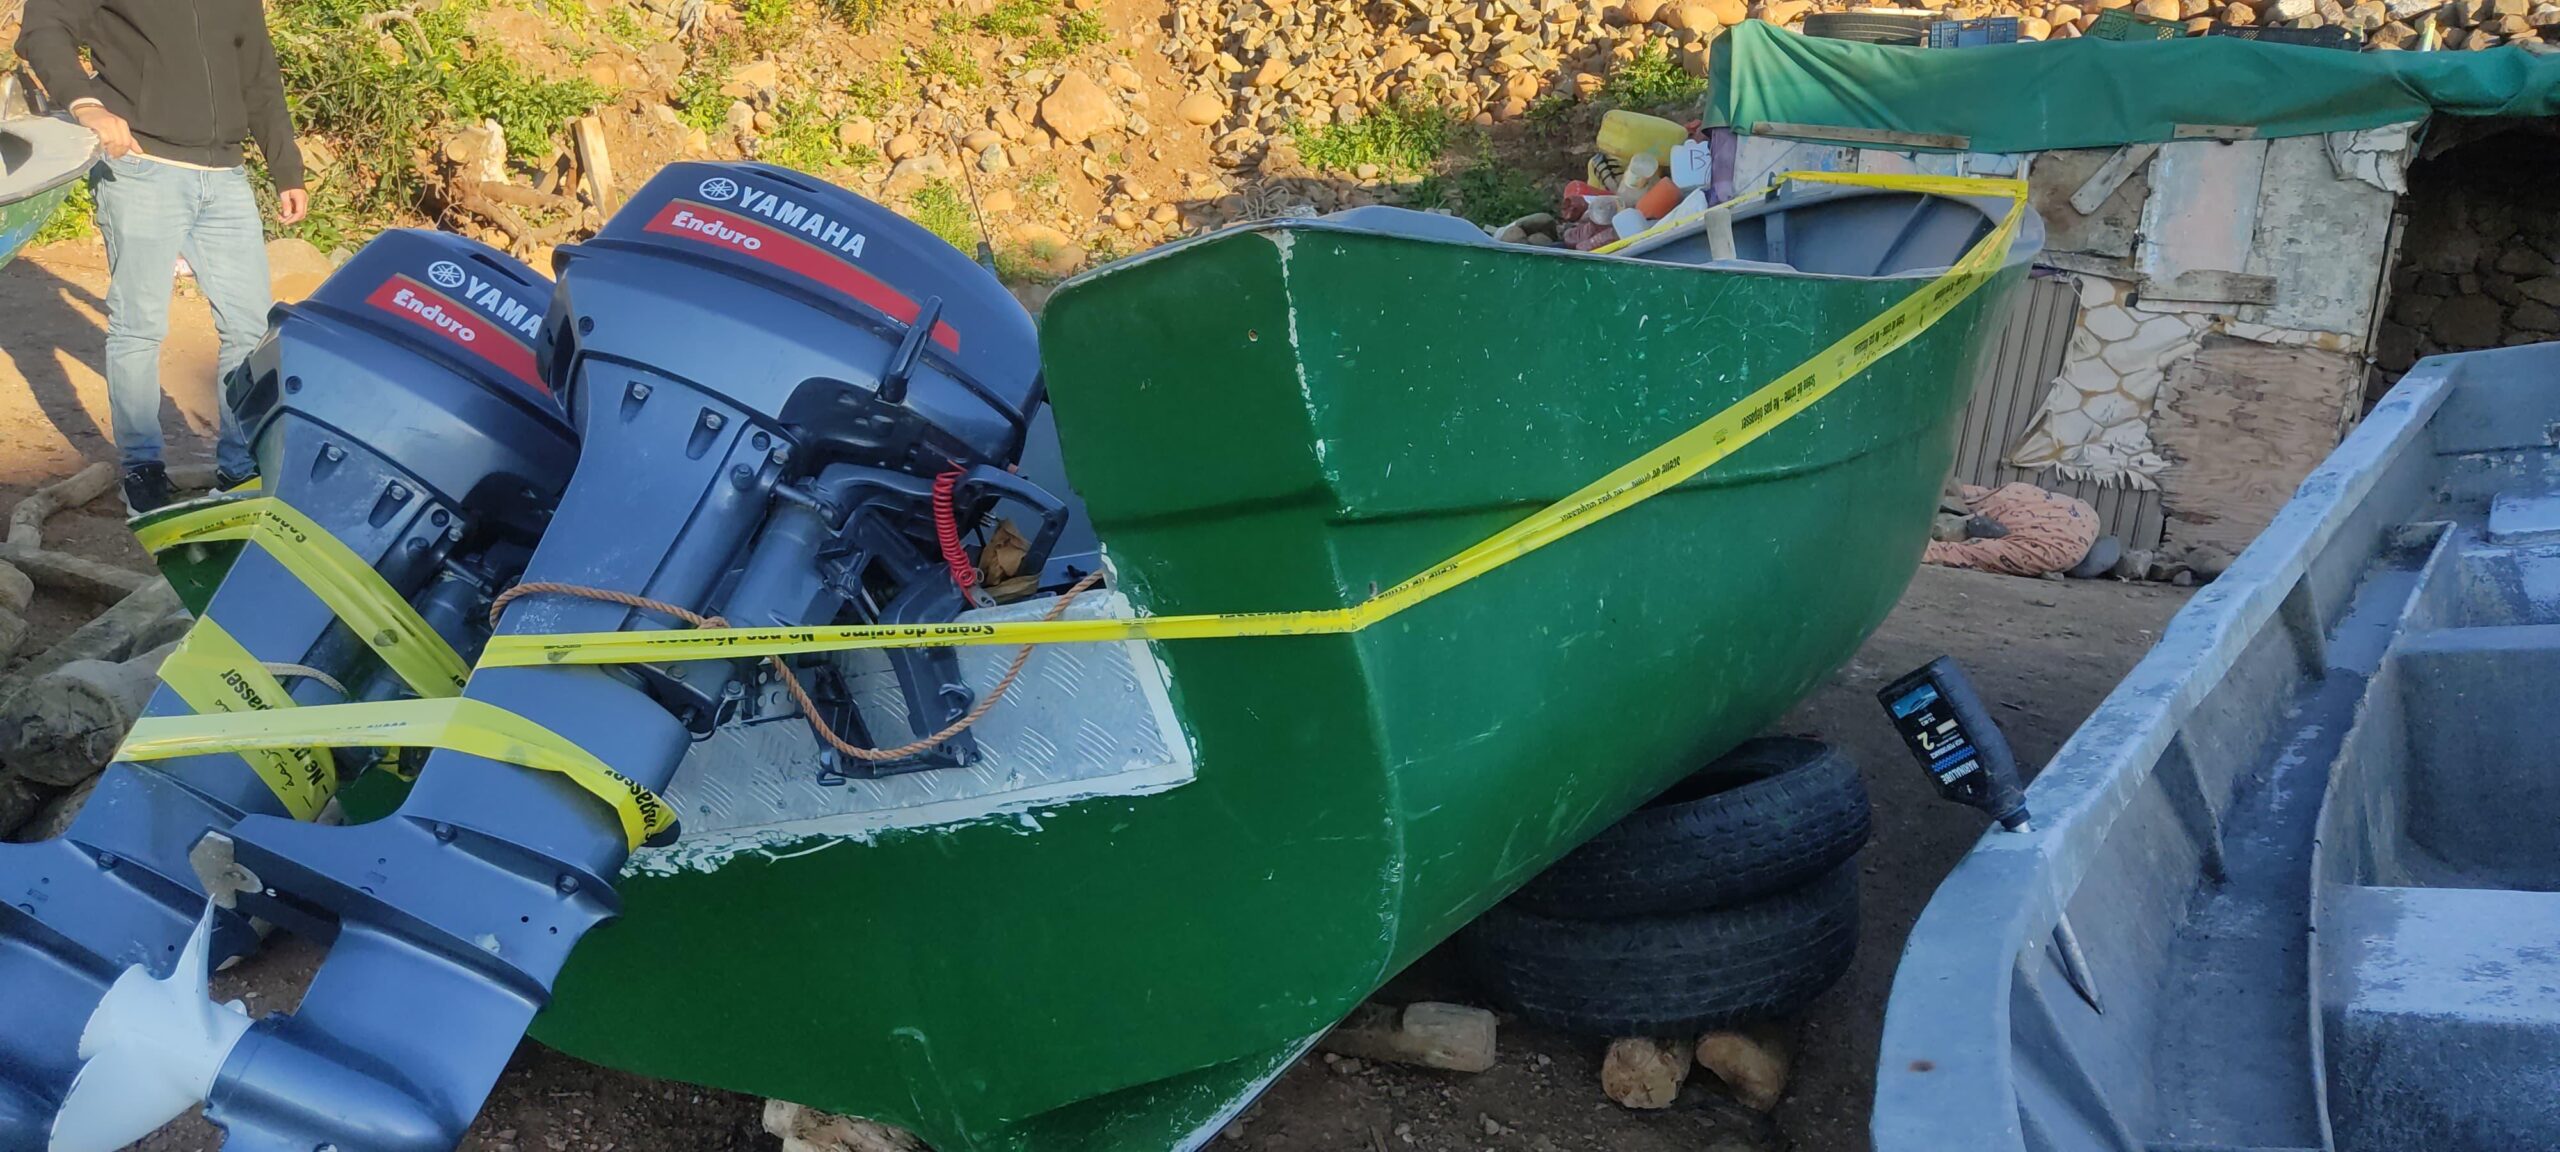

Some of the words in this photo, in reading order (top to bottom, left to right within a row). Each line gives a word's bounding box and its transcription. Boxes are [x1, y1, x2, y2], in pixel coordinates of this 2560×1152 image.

[671, 210, 762, 251] Enduro
[739, 185, 868, 258] YAMAHA
[392, 288, 476, 343] Enduro
[464, 274, 542, 339] YAMA
[1916, 731, 1935, 751] 2
